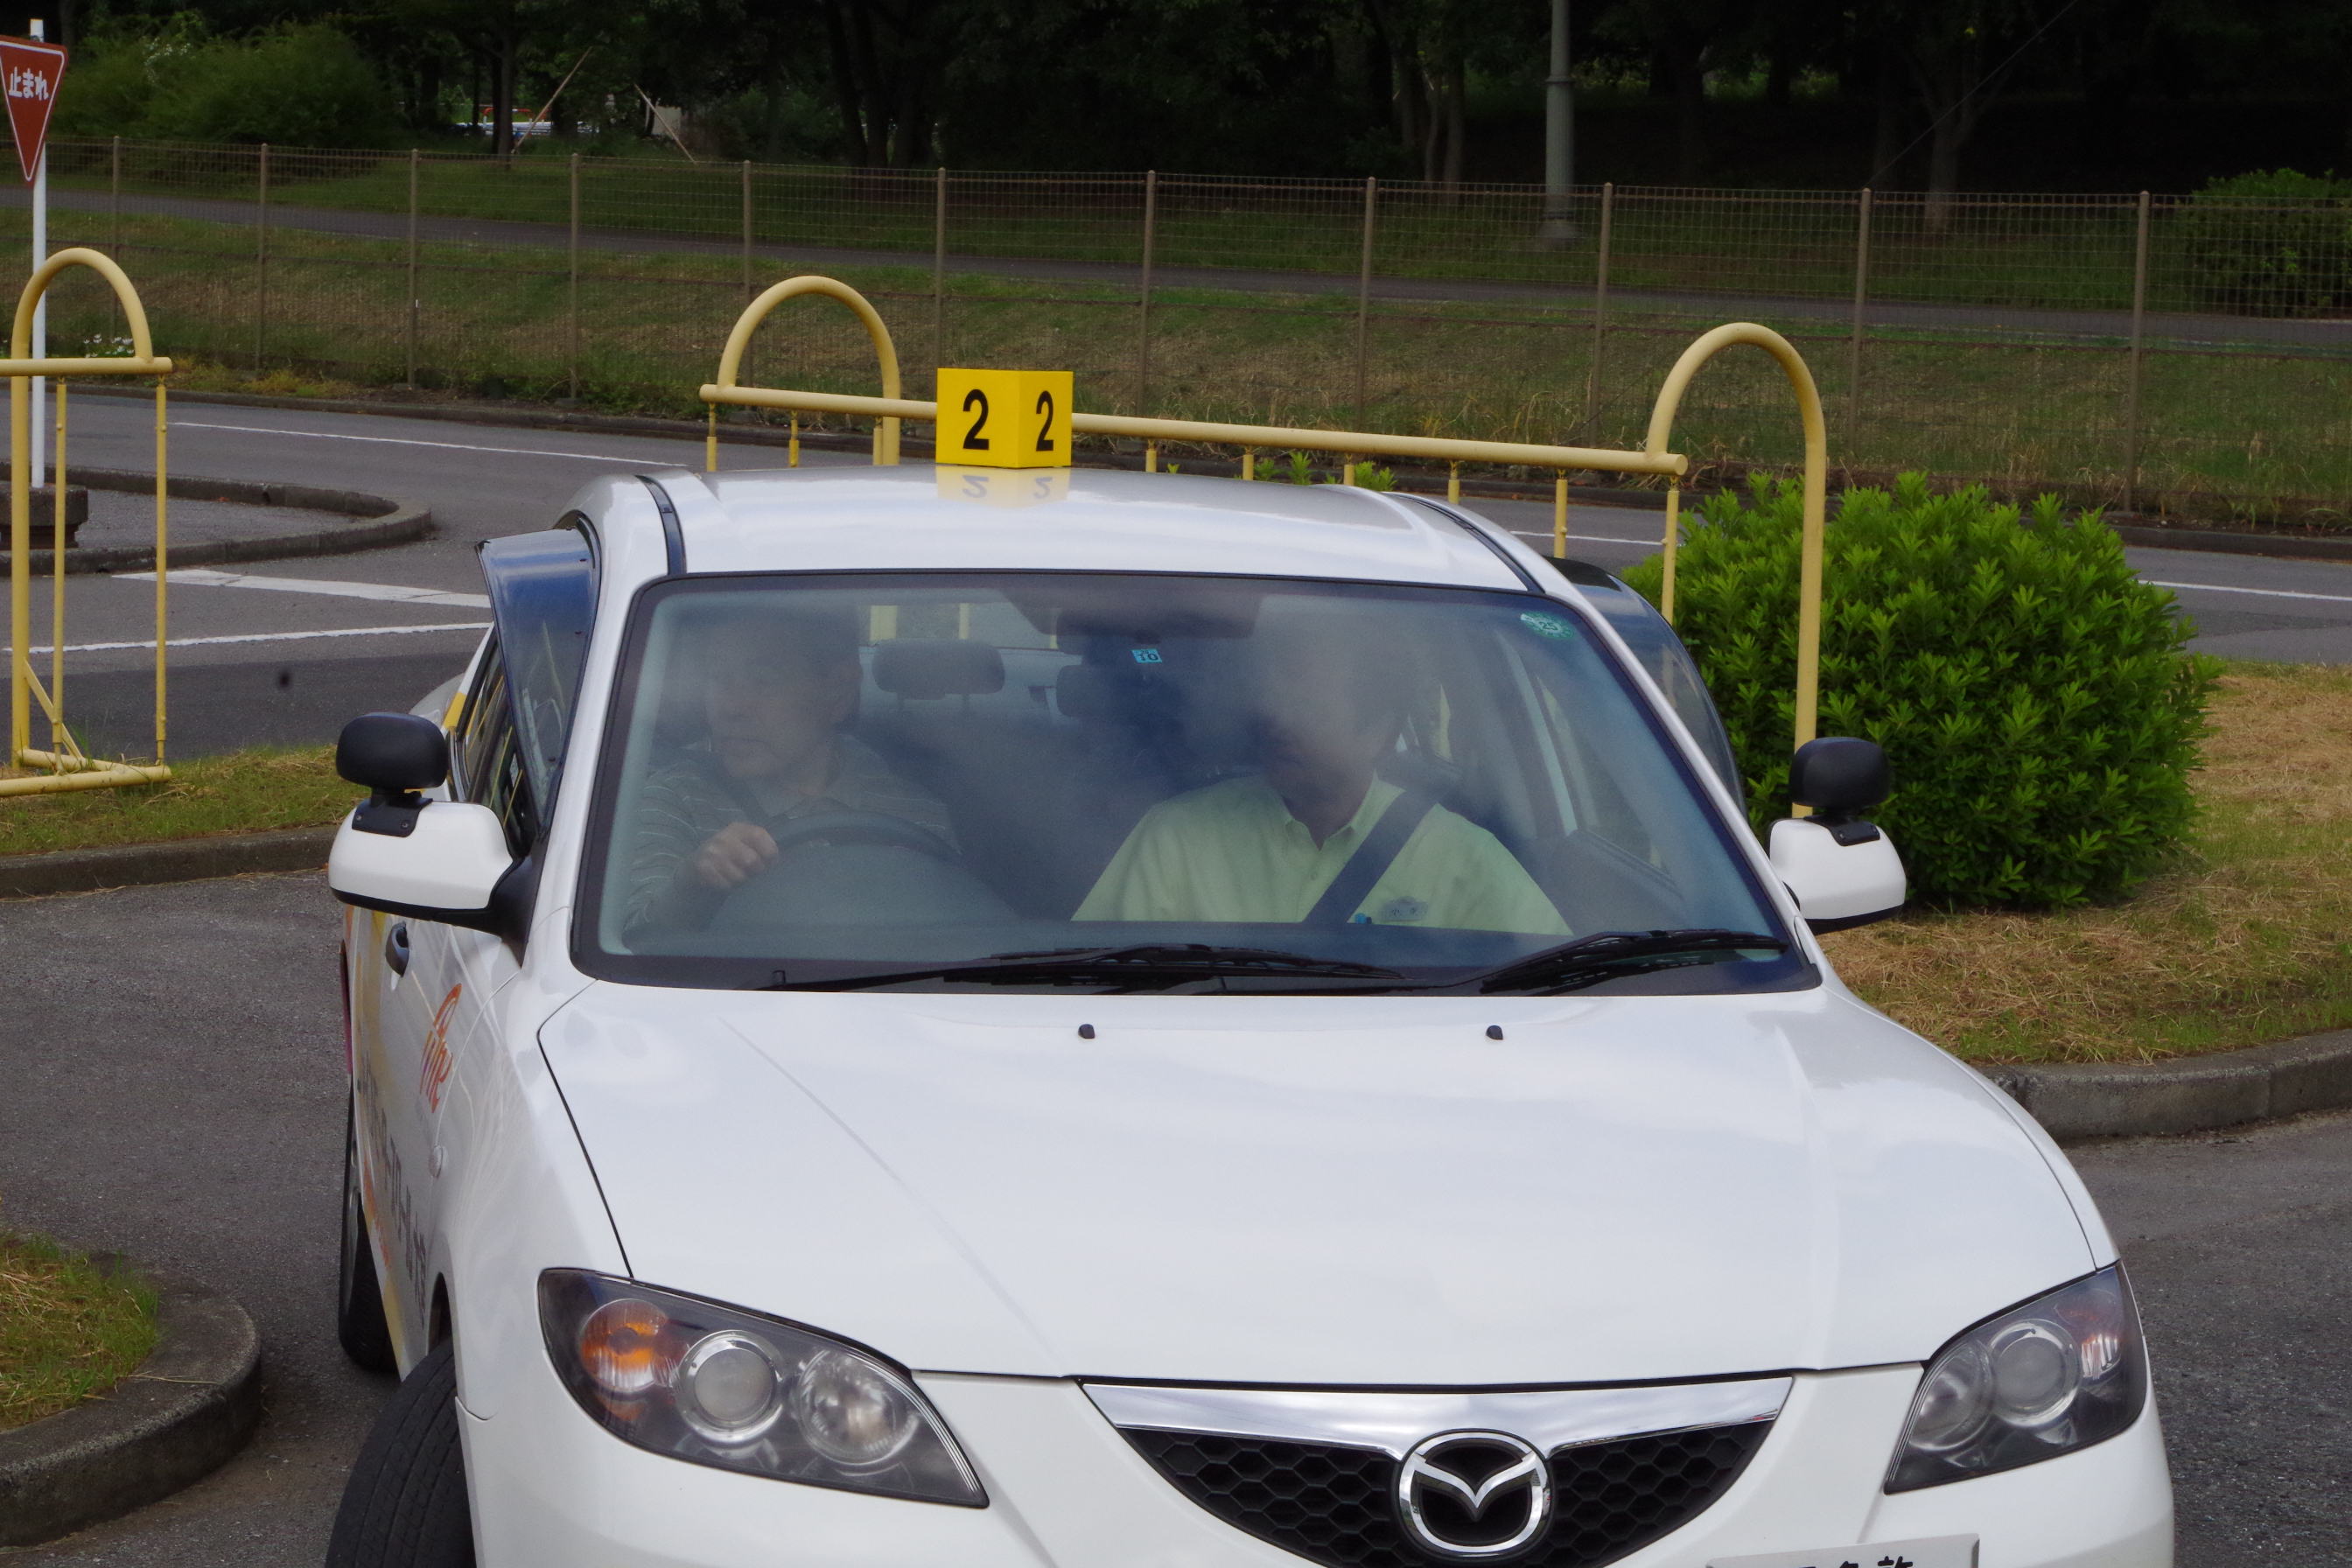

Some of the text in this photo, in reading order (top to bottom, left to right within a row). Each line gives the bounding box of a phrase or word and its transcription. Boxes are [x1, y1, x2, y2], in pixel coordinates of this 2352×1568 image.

[8, 66, 49, 101] 止まれ
[962, 388, 990, 451] 2
[1036, 390, 1054, 452] 2
